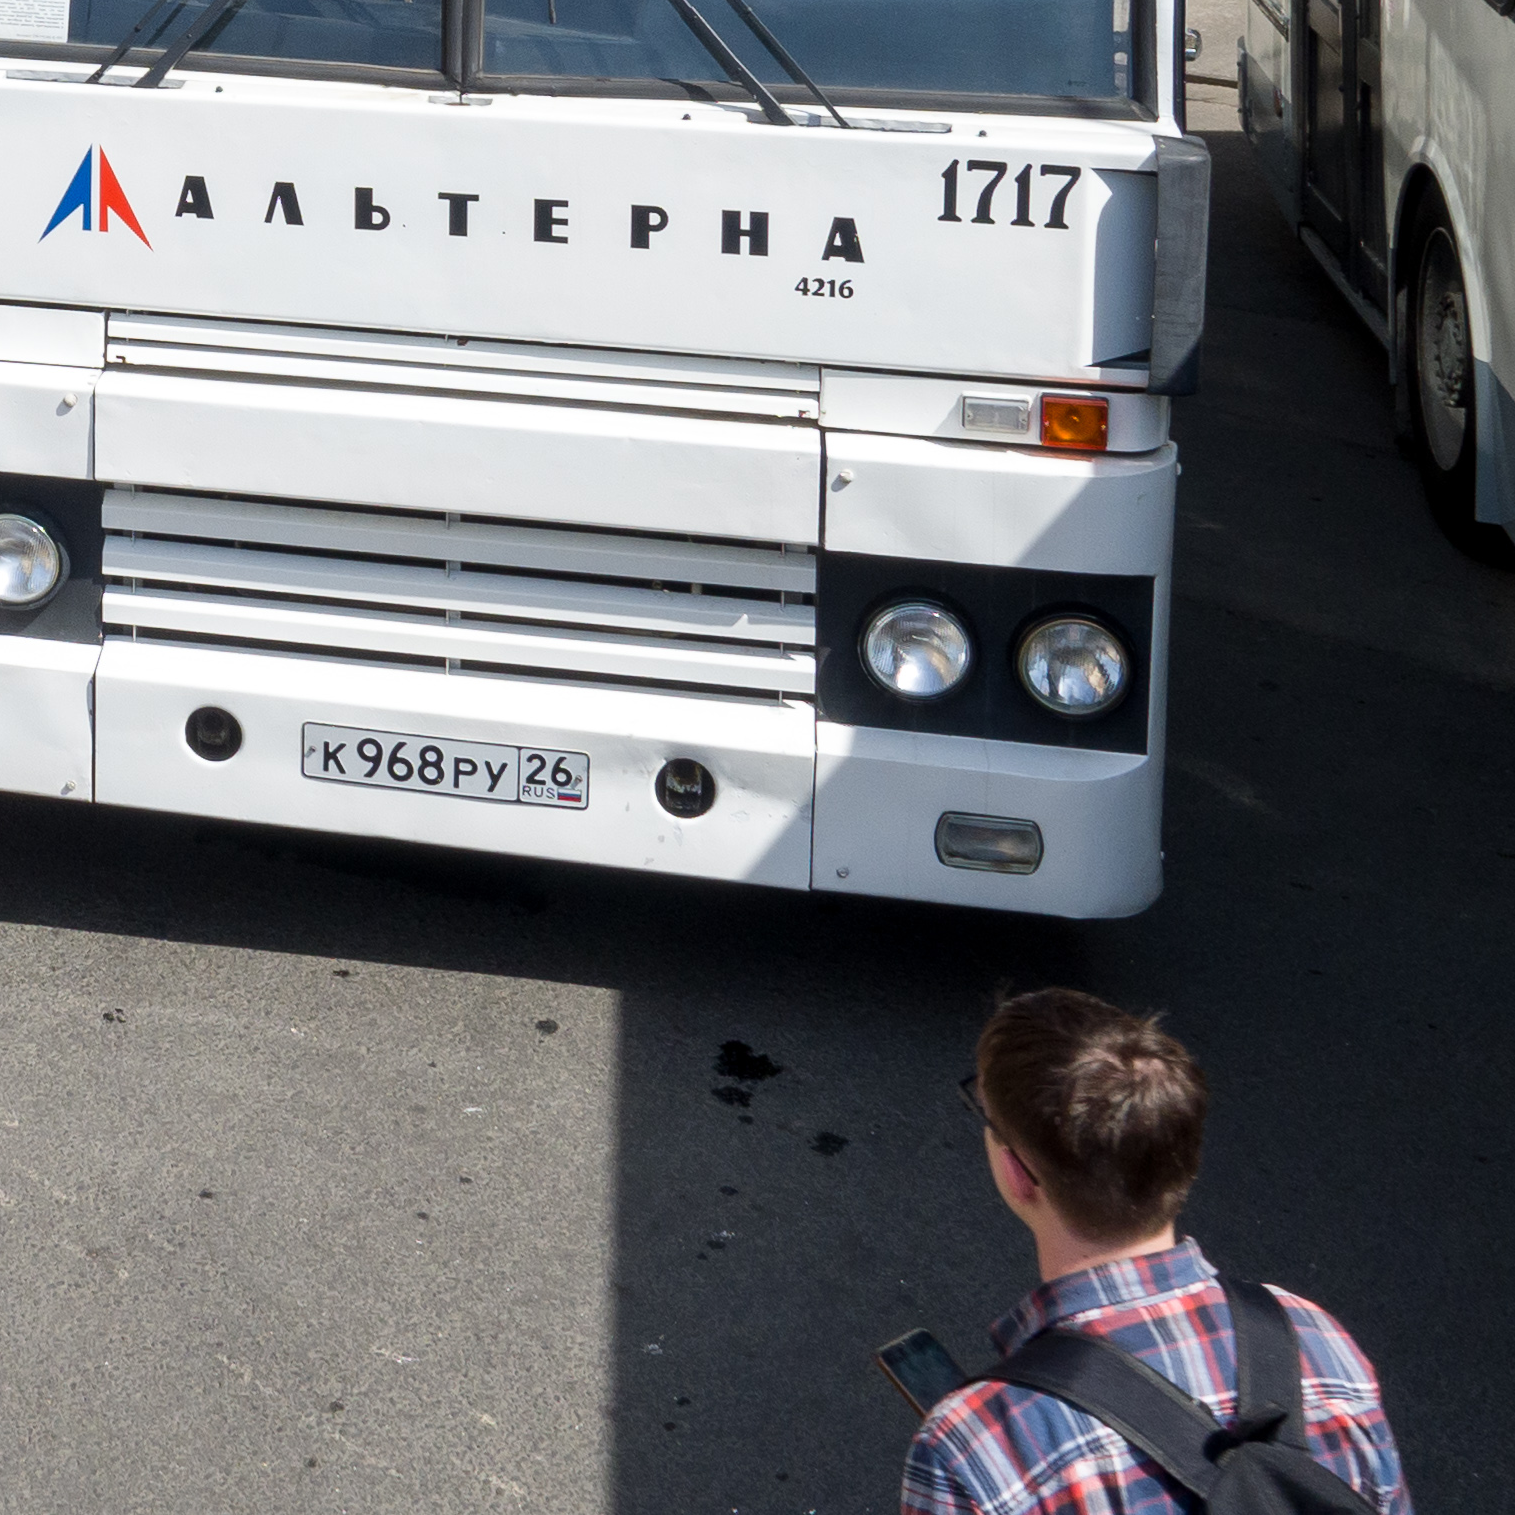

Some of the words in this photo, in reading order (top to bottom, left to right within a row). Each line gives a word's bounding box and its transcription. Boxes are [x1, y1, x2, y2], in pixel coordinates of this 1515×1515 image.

[174, 175, 865, 263] АЛЬТЕРНА
[937, 159, 1082, 229] 1717
[795, 276, 855, 300] 4216
[322, 737, 508, 793] К968РУ
[525, 753, 574, 787] 26
[521, 785, 556, 800] RUS
